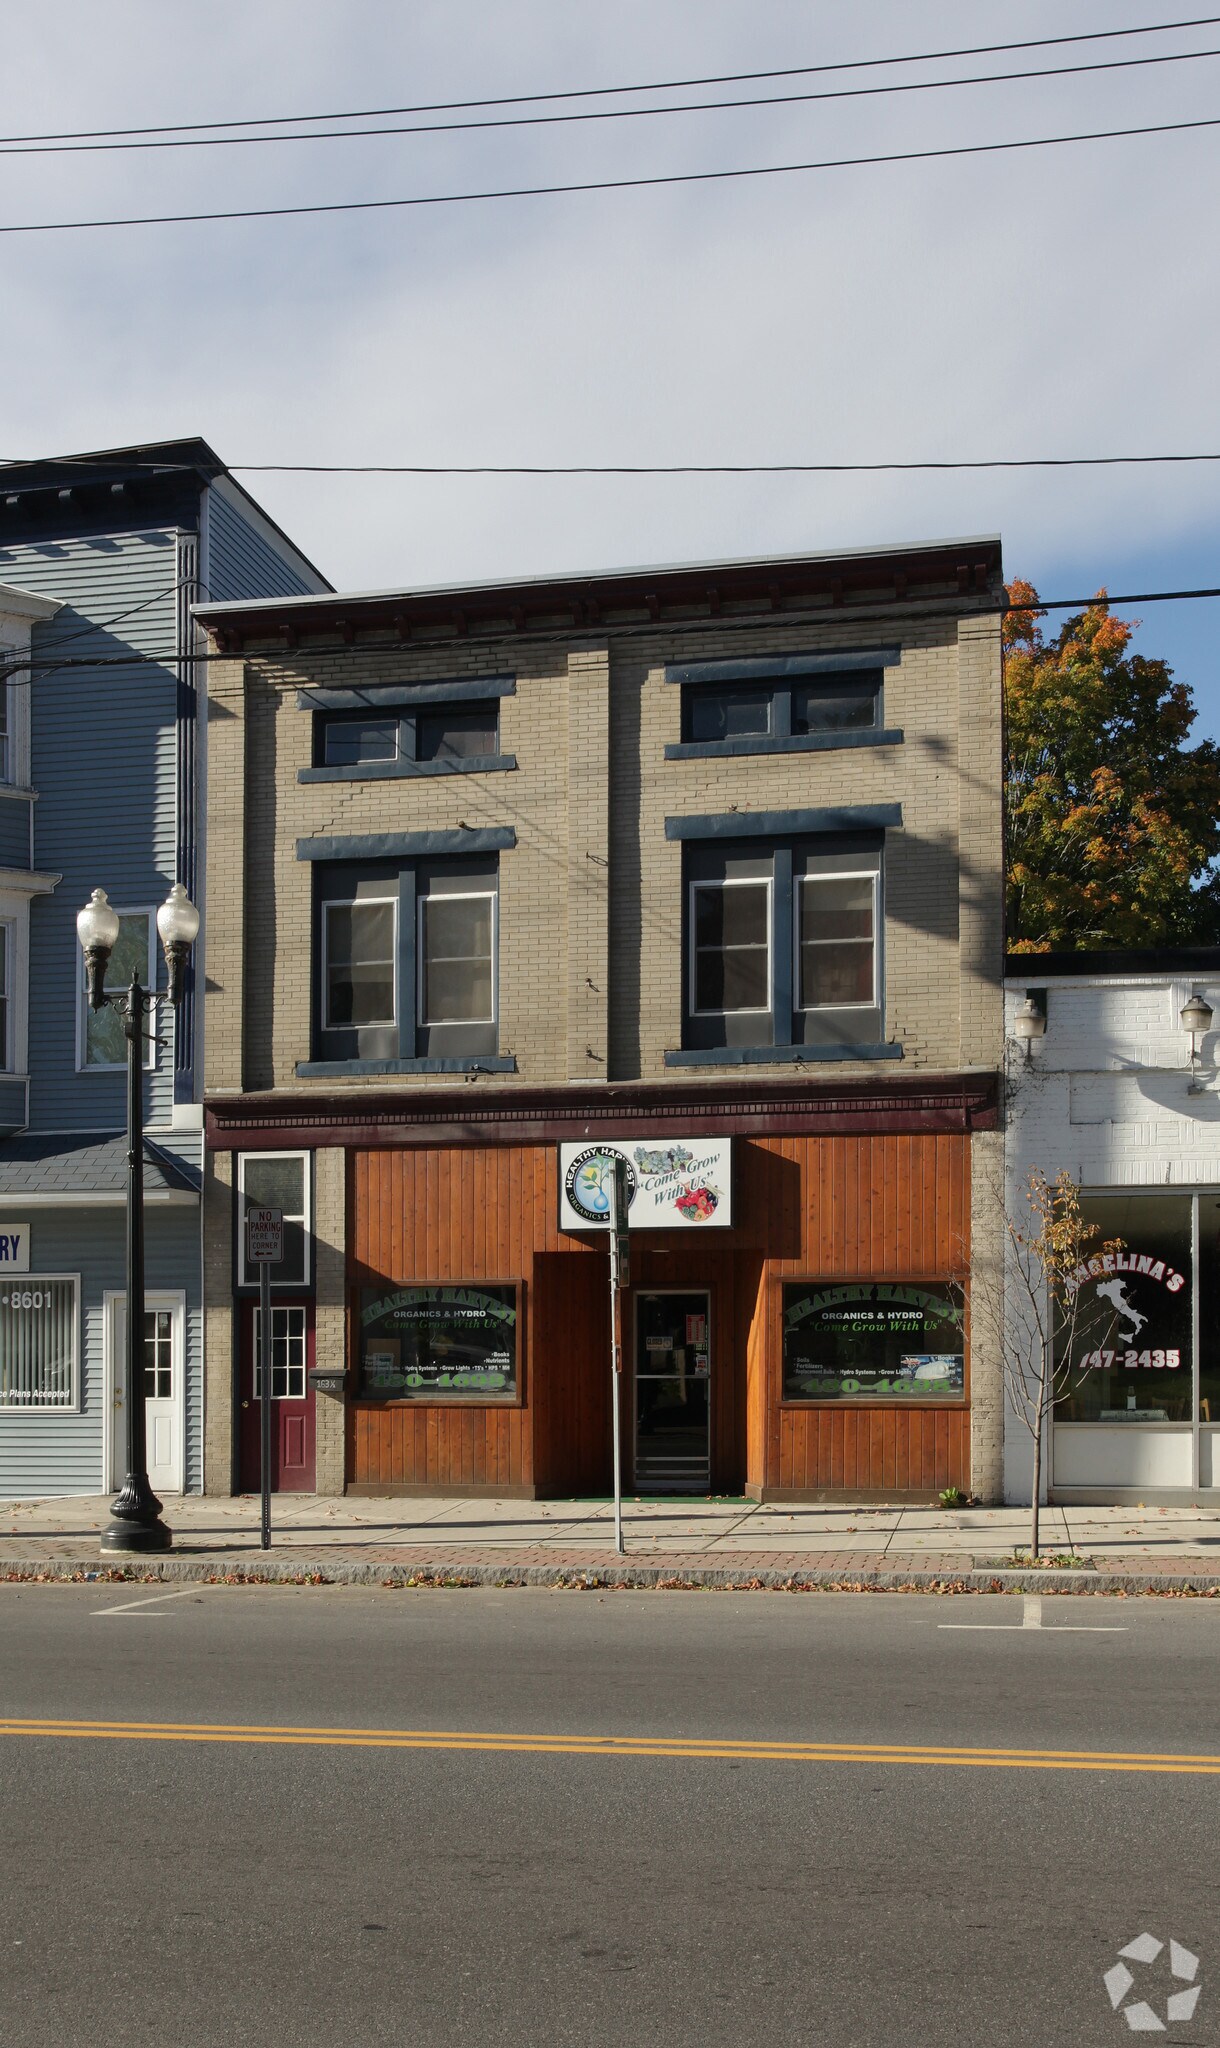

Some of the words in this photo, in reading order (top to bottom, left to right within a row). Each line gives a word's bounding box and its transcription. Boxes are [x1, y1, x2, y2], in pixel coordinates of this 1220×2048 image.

[566, 1147, 598, 1189] HEALTHY
[686, 1153, 720, 1173] Grow
[653, 1185, 685, 1206] With
[569, 1193, 602, 1220] ORGANICS
[258, 1211, 272, 1221] NO
[250, 1222, 281, 1232] PARKING
[252, 1241, 278, 1249] CORNER
[362, 1287, 439, 1327] HEALTHY
[441, 1287, 516, 1327] HARVEST
[785, 1284, 873, 1325] HEALTHY
[876, 1284, 963, 1325] HARVEST
[393, 1310, 441, 1318] ORGANICS
[444, 1310, 451, 1318] &
[453, 1310, 486, 1318] HYDRO
[821, 1311, 874, 1320] ORGANICS
[877, 1311, 885, 1320] &
[887, 1311, 923, 1320] HYDRO
[419, 1319, 450, 1329] Grow
[452, 1319, 480, 1329] With
[851, 1321, 886, 1332] Grow
[890, 1320, 919, 1332] With
[800, 1378, 951, 1393] 480-4698
[9, 1389, 31, 1398] Plans
[32, 1389, 70, 1400] Accepted
